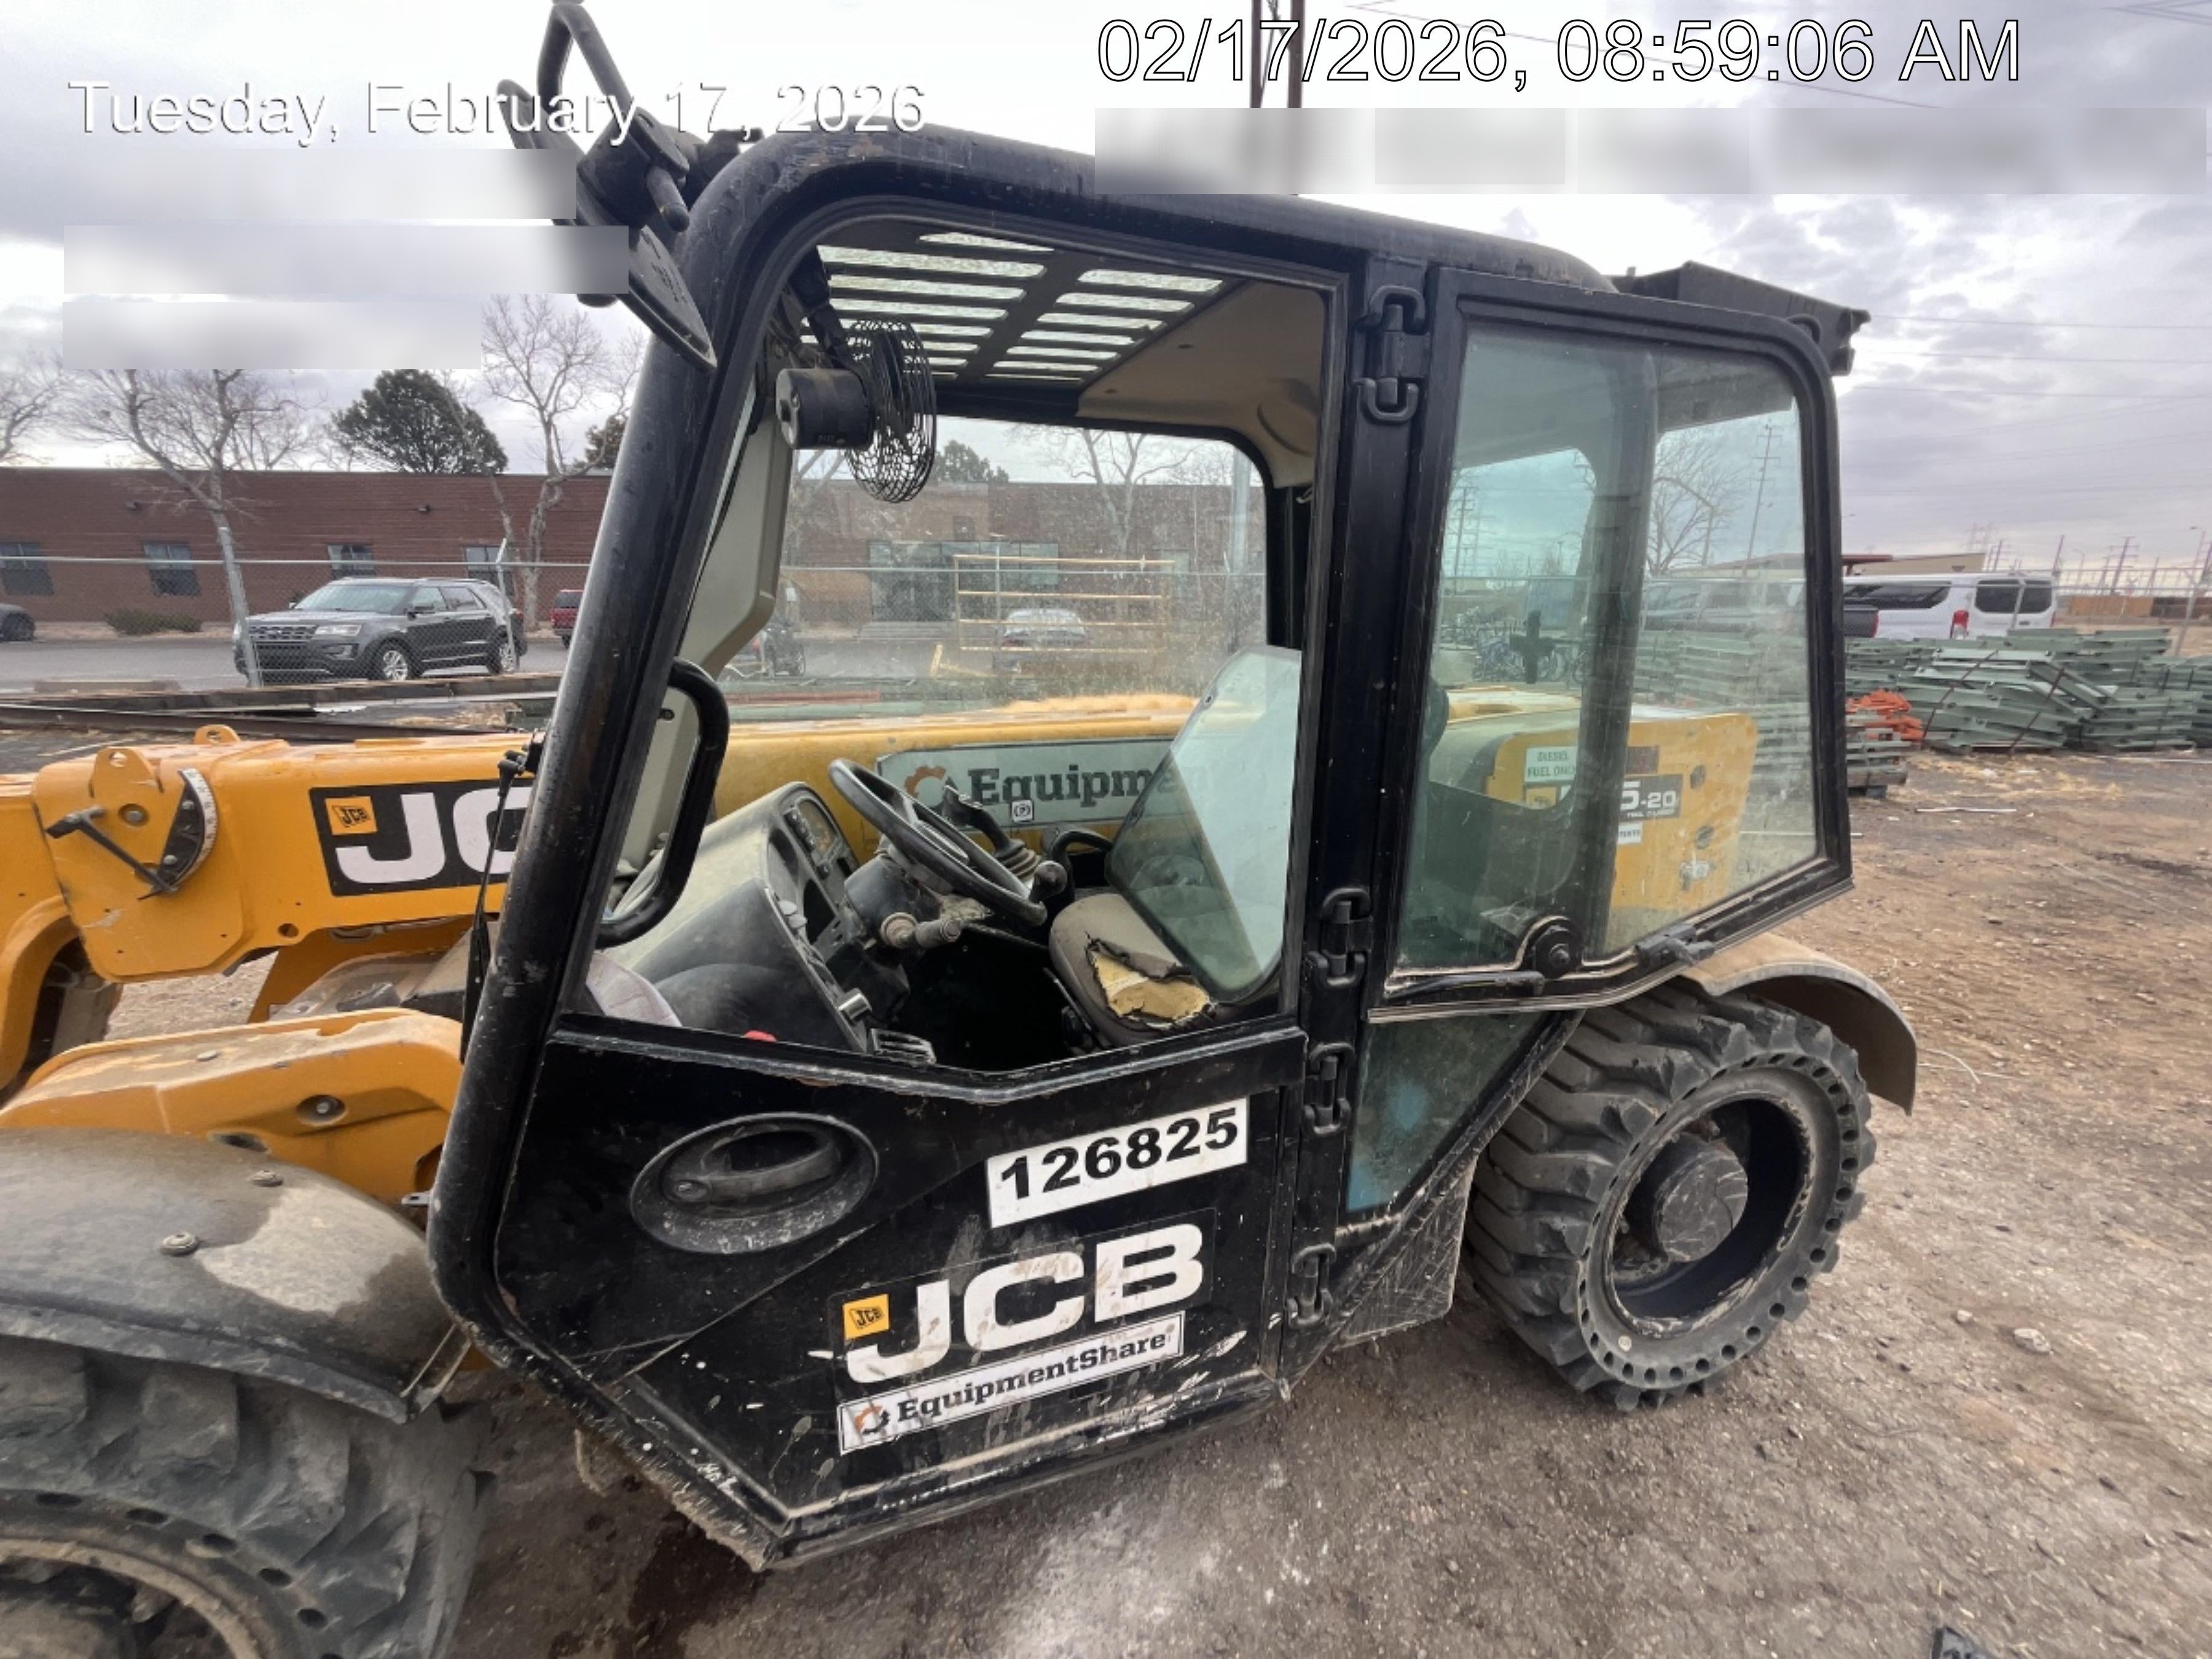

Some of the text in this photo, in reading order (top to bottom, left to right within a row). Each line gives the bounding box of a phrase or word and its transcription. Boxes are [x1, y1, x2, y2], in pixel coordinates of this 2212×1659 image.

[335, 786, 533, 884] JC
[337, 807, 370, 826] JCB
[1620, 781, 1677, 811] 5-20
[1000, 1108, 1238, 1200] 126825
[847, 1223, 1204, 1384] JCB
[853, 1308, 883, 1327] JCB
[896, 1332, 1167, 1424] EquipmentShare
